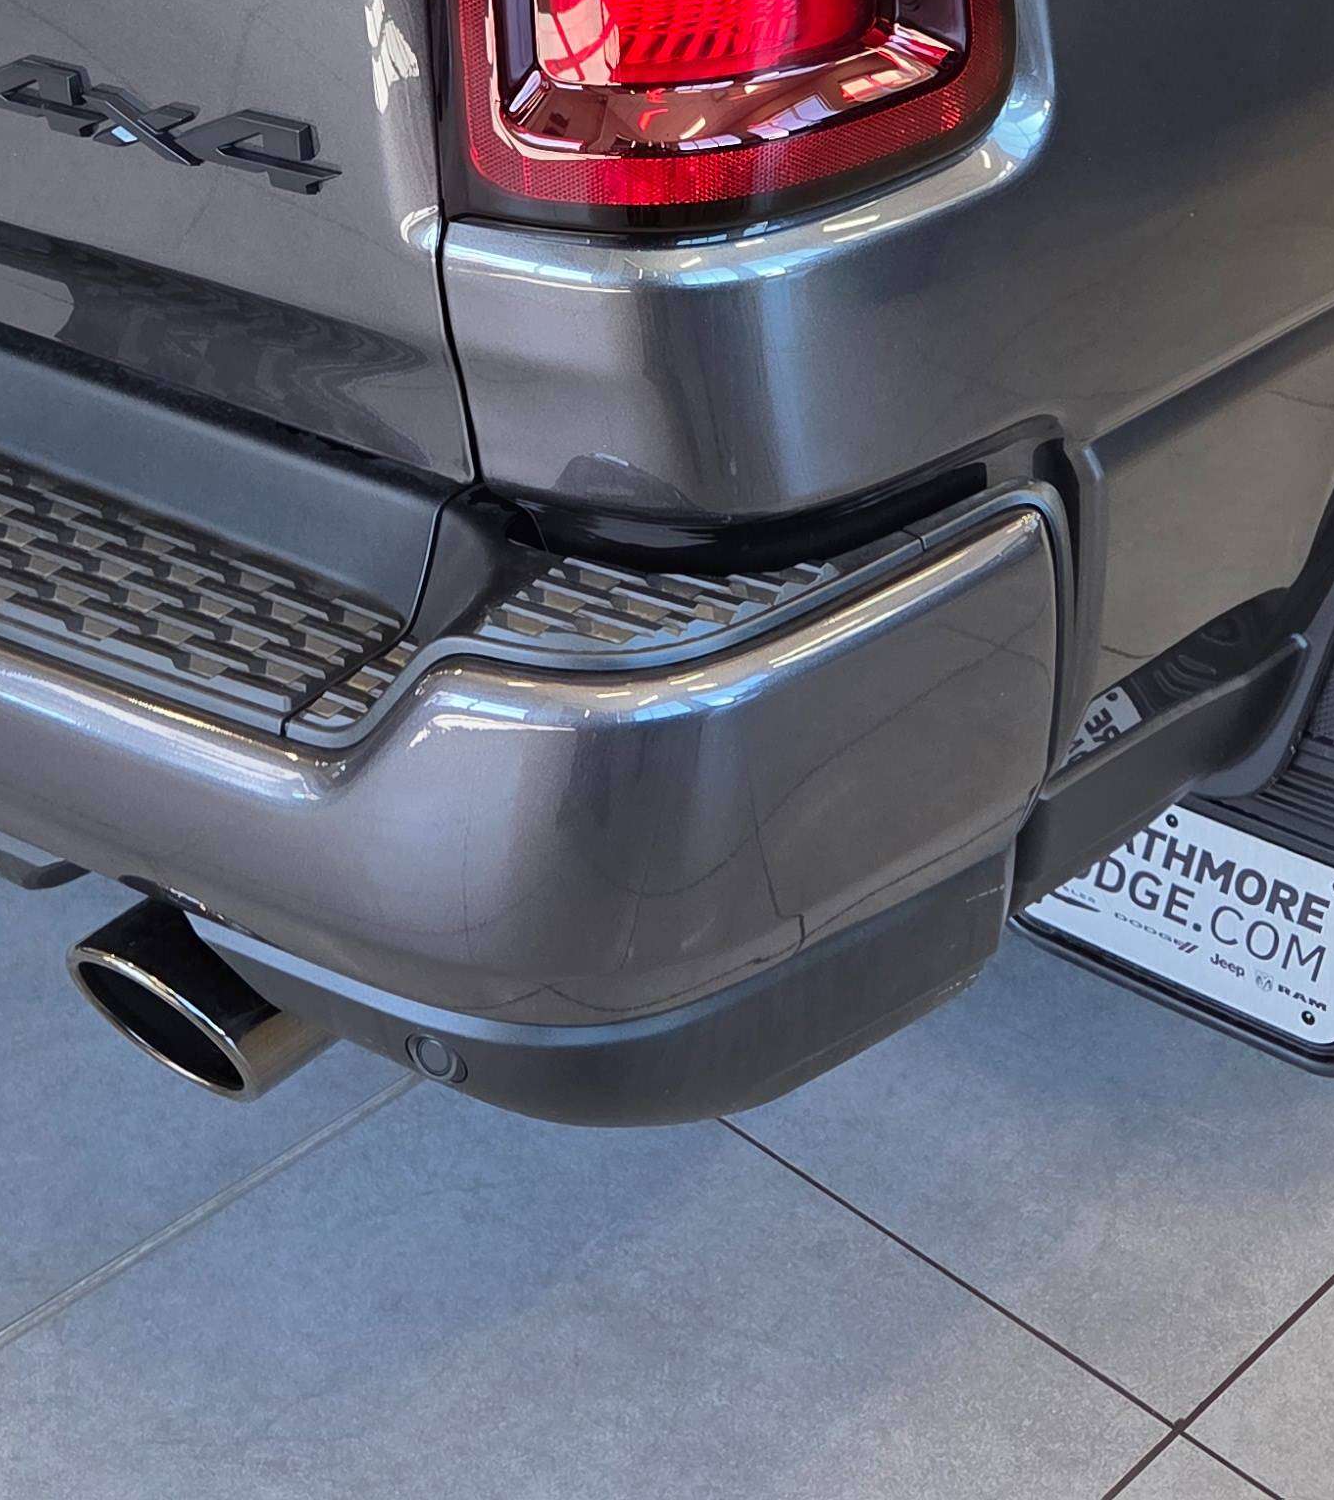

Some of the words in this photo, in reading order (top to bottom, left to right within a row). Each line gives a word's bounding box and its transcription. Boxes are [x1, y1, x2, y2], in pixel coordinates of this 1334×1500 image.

[1079, 856, 1327, 983] DGE.COM
[1210, 953, 1246, 978] Jeep
[1277, 984, 1328, 1012] RAM
